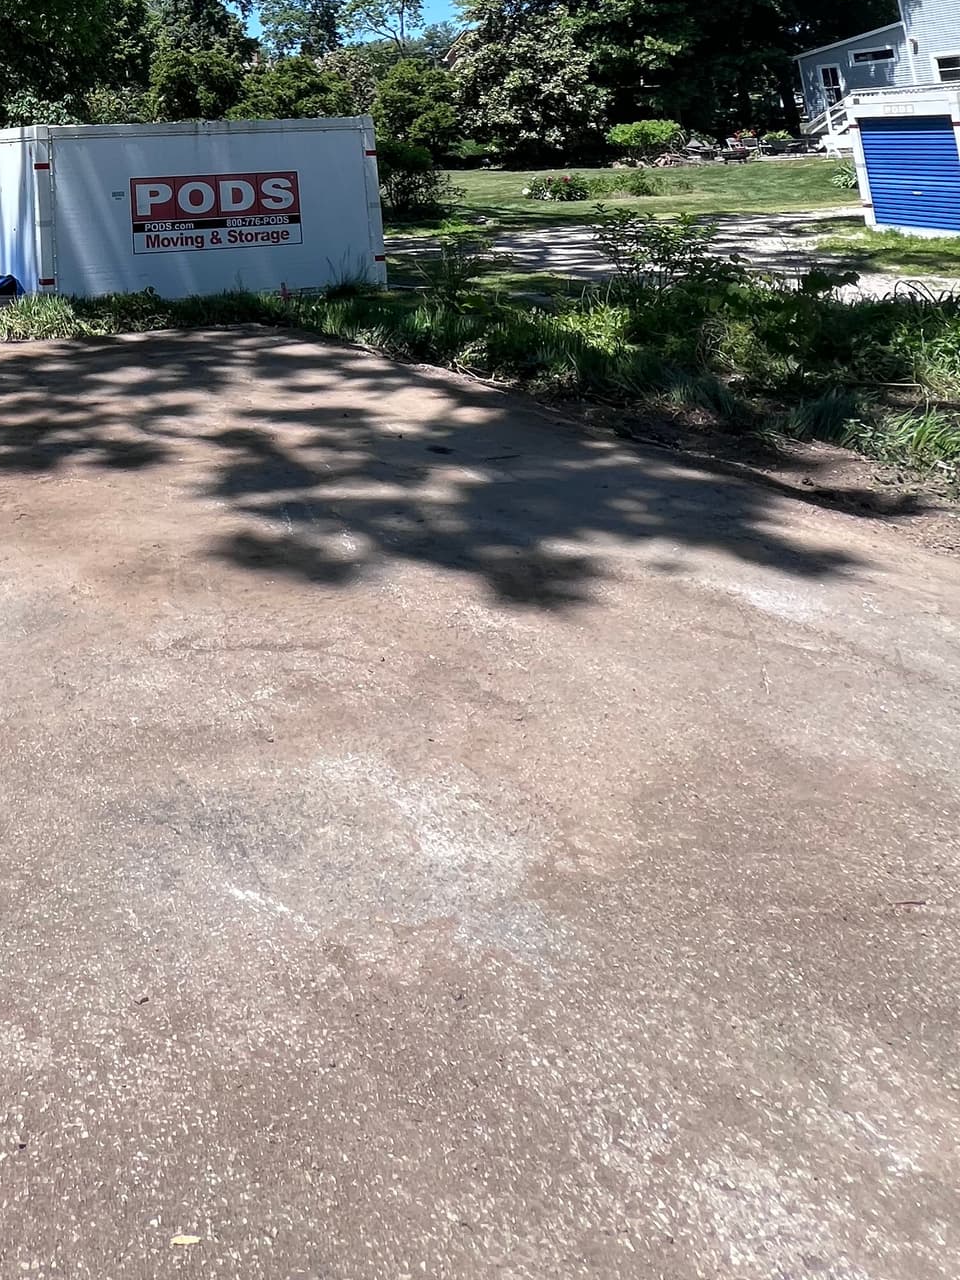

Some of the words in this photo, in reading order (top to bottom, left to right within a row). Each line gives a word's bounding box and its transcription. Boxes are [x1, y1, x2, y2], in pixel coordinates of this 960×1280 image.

[135, 177, 295, 216] PODS
[144, 222, 194, 231] PODS.com
[226, 216, 289, 227] 800-776-PODS
[145, 232, 205, 249] Moving
[210, 230, 222, 245] &
[227, 229, 290, 244] Storage
